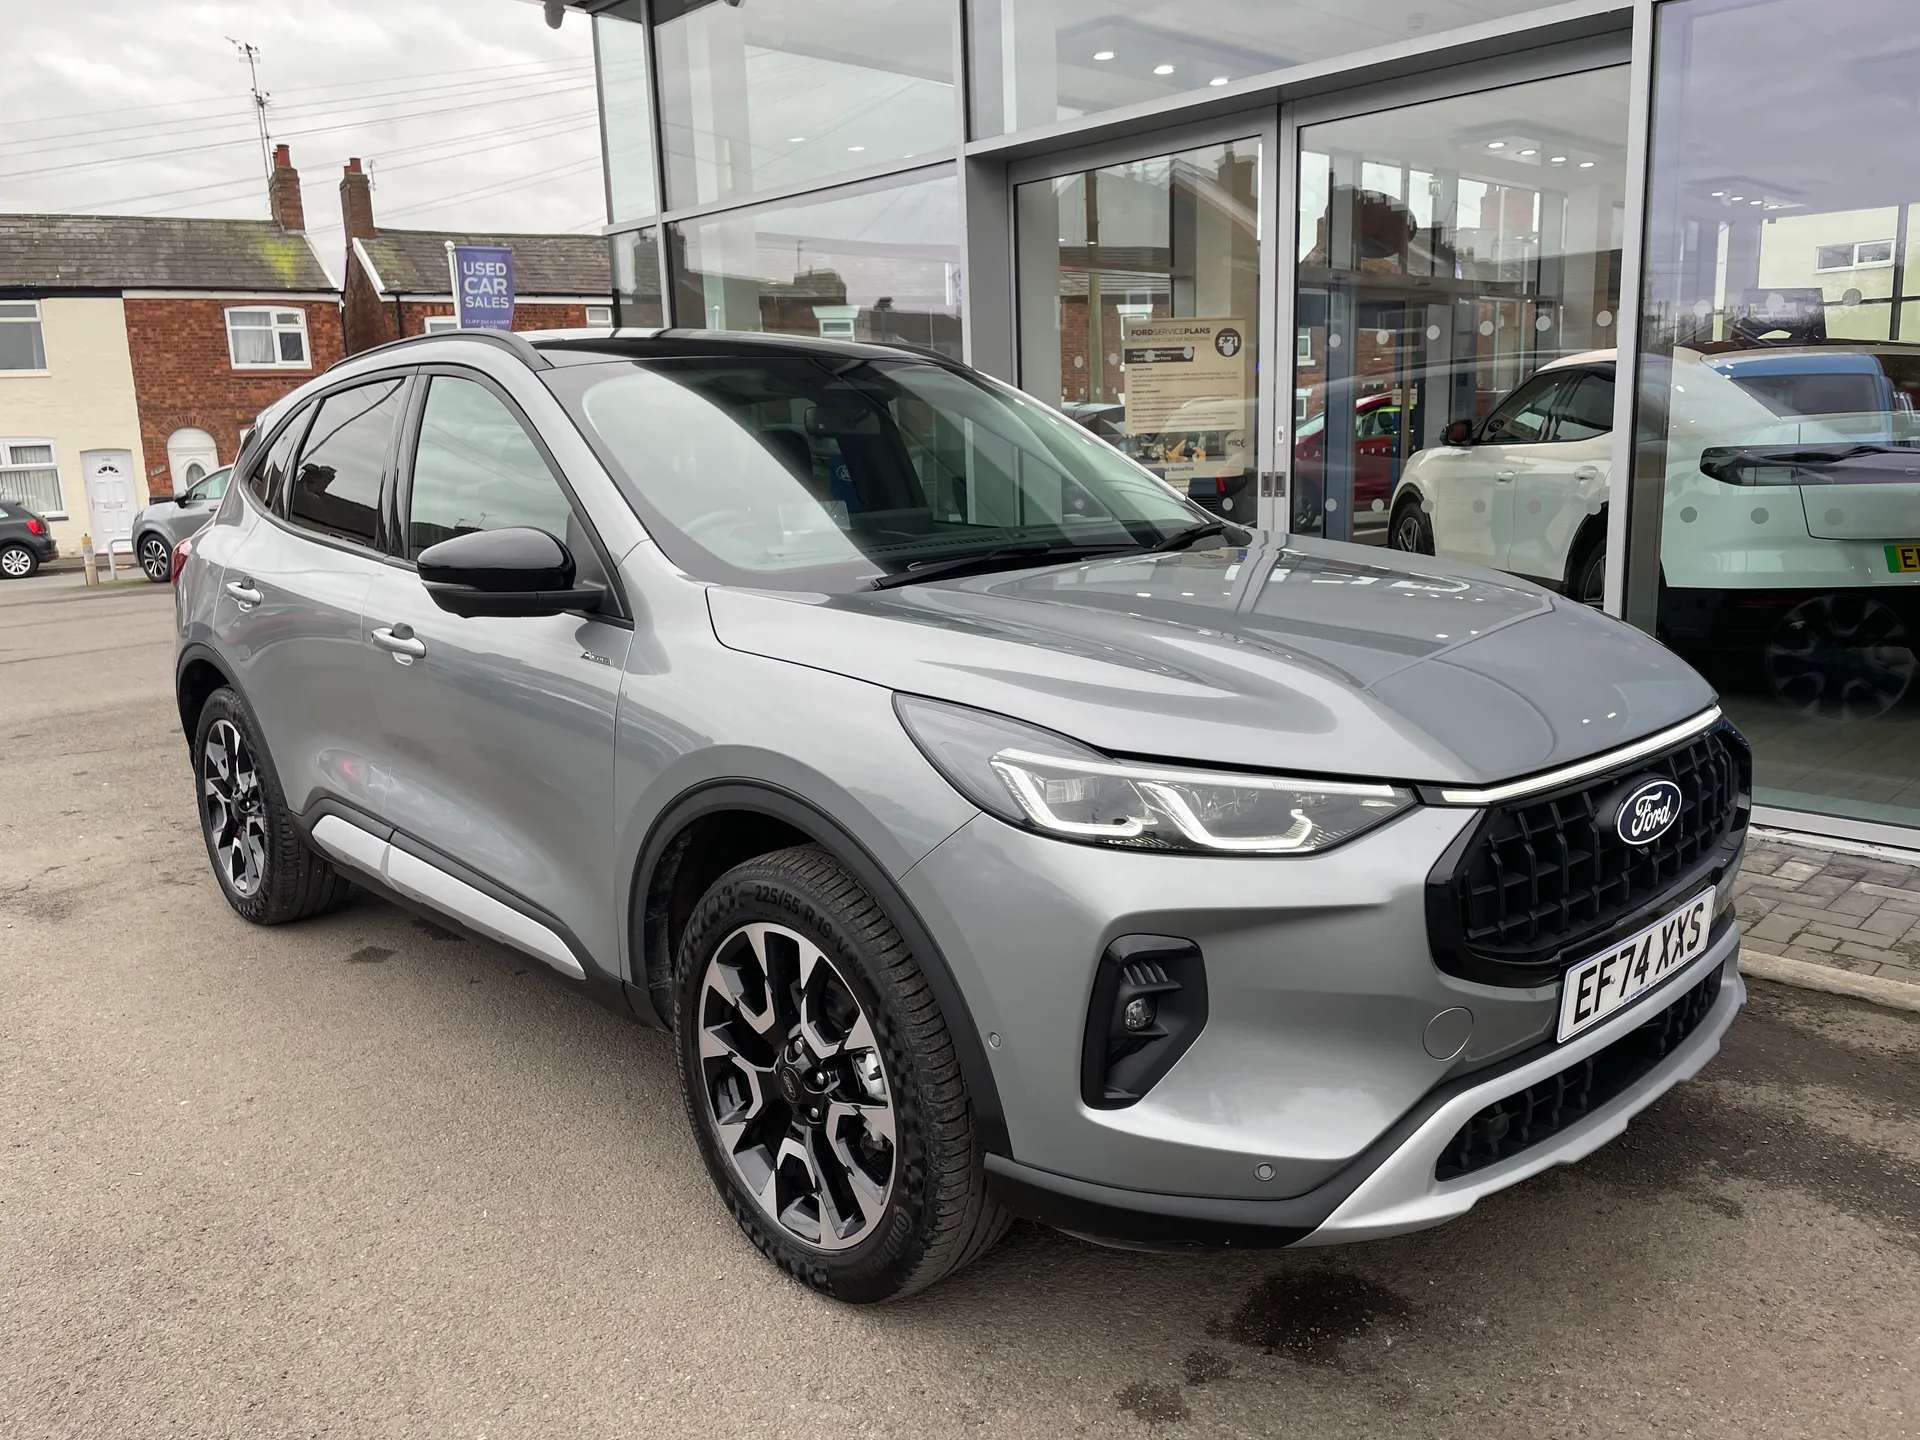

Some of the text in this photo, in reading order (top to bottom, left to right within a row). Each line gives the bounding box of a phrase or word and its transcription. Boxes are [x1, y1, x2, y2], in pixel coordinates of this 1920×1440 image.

[463, 261, 507, 276] USED
[464, 276, 508, 295] CAR
[465, 295, 509, 309] SALES
[1901, 548, 1920, 569] E
[1631, 790, 1672, 837] Ford
[1573, 901, 1704, 1026] EF74 XXS
